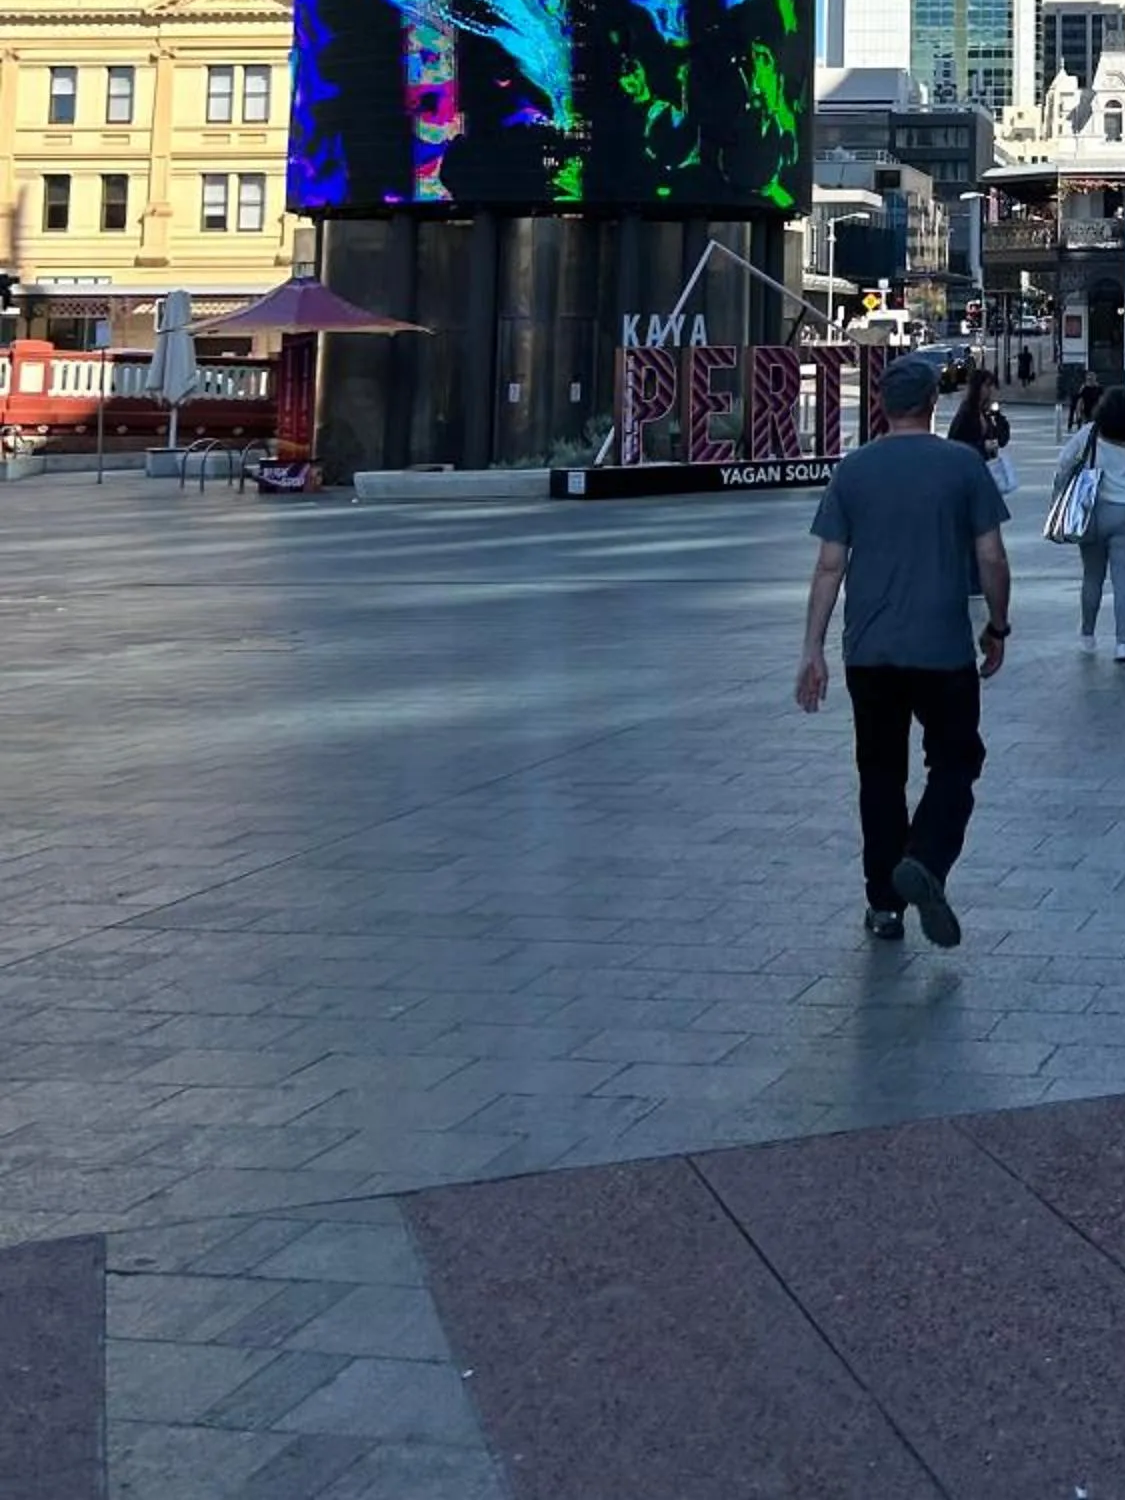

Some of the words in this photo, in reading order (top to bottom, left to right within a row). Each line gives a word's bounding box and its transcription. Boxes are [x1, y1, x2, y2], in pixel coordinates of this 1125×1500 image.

[622, 313, 708, 347] KAYA
[720, 466, 781, 485] YAGAN
[785, 463, 837, 481] SQUA
